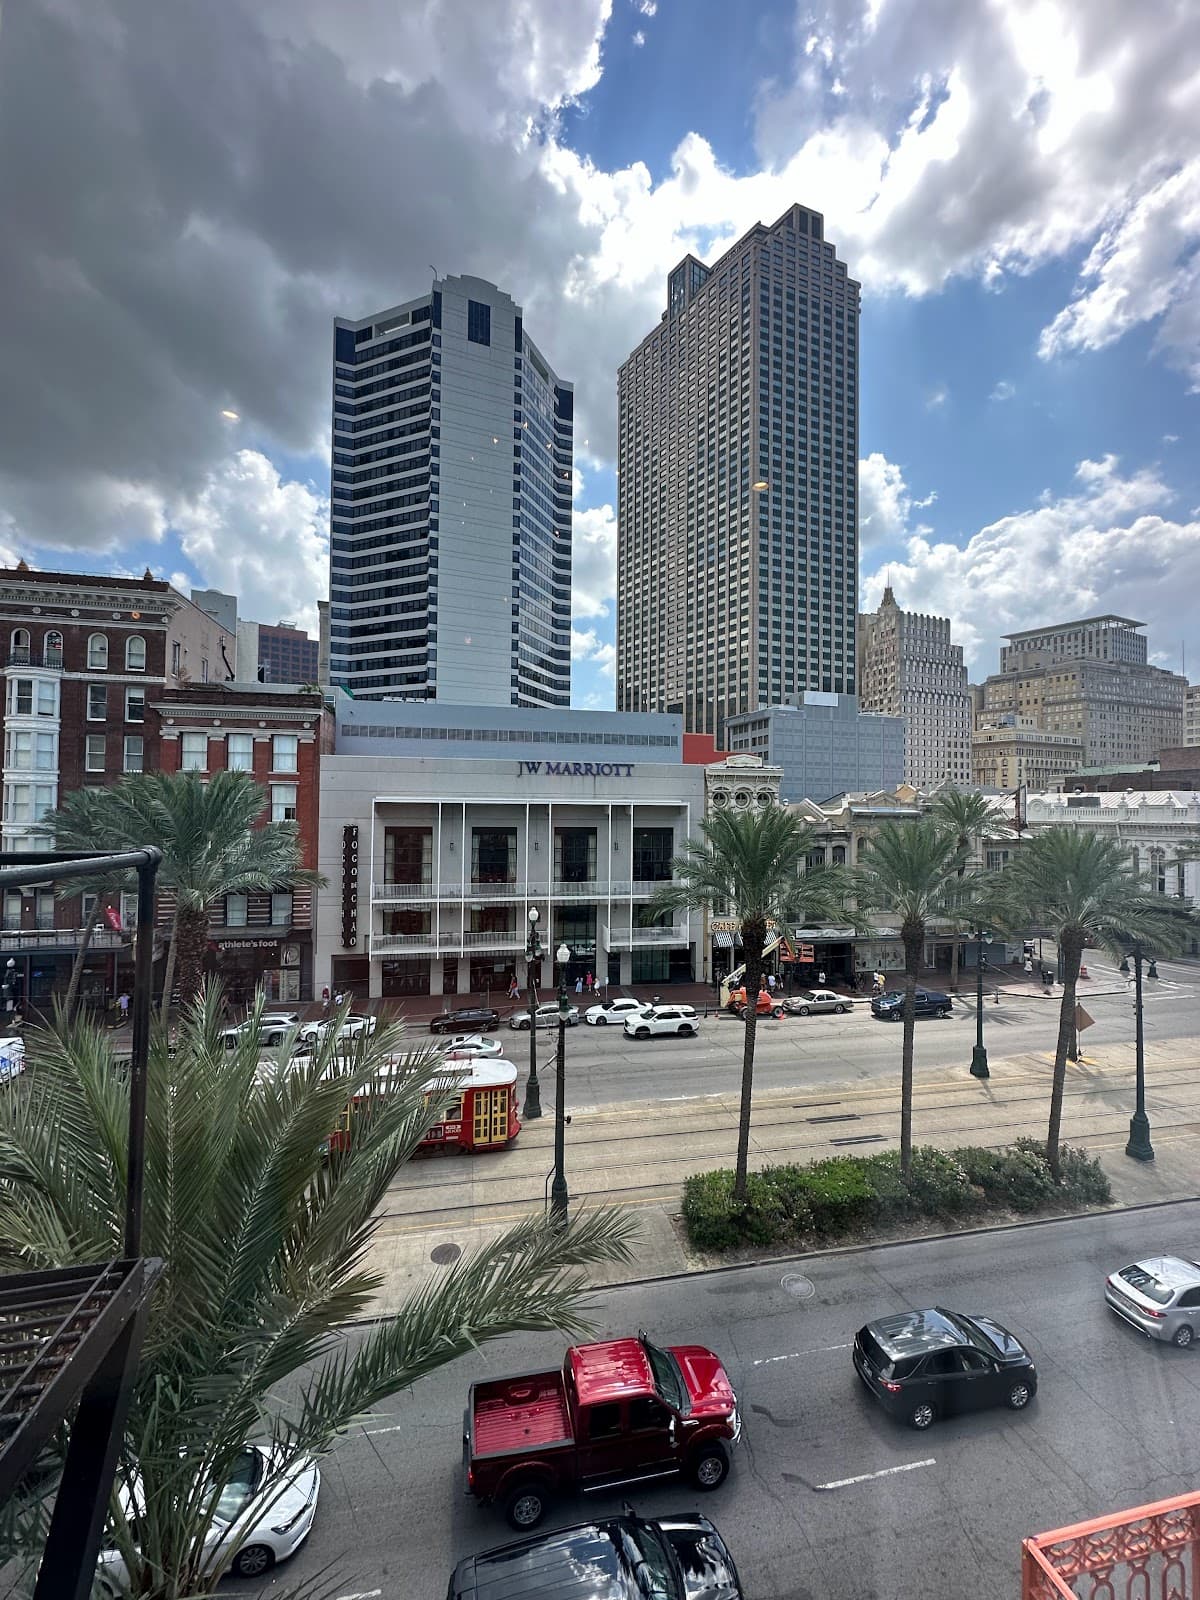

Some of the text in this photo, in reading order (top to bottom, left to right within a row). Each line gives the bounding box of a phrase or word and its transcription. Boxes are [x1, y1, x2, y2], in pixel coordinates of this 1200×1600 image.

[517, 760, 635, 778] JW MARRIOTT
[218, 940, 258, 948] athlete's
